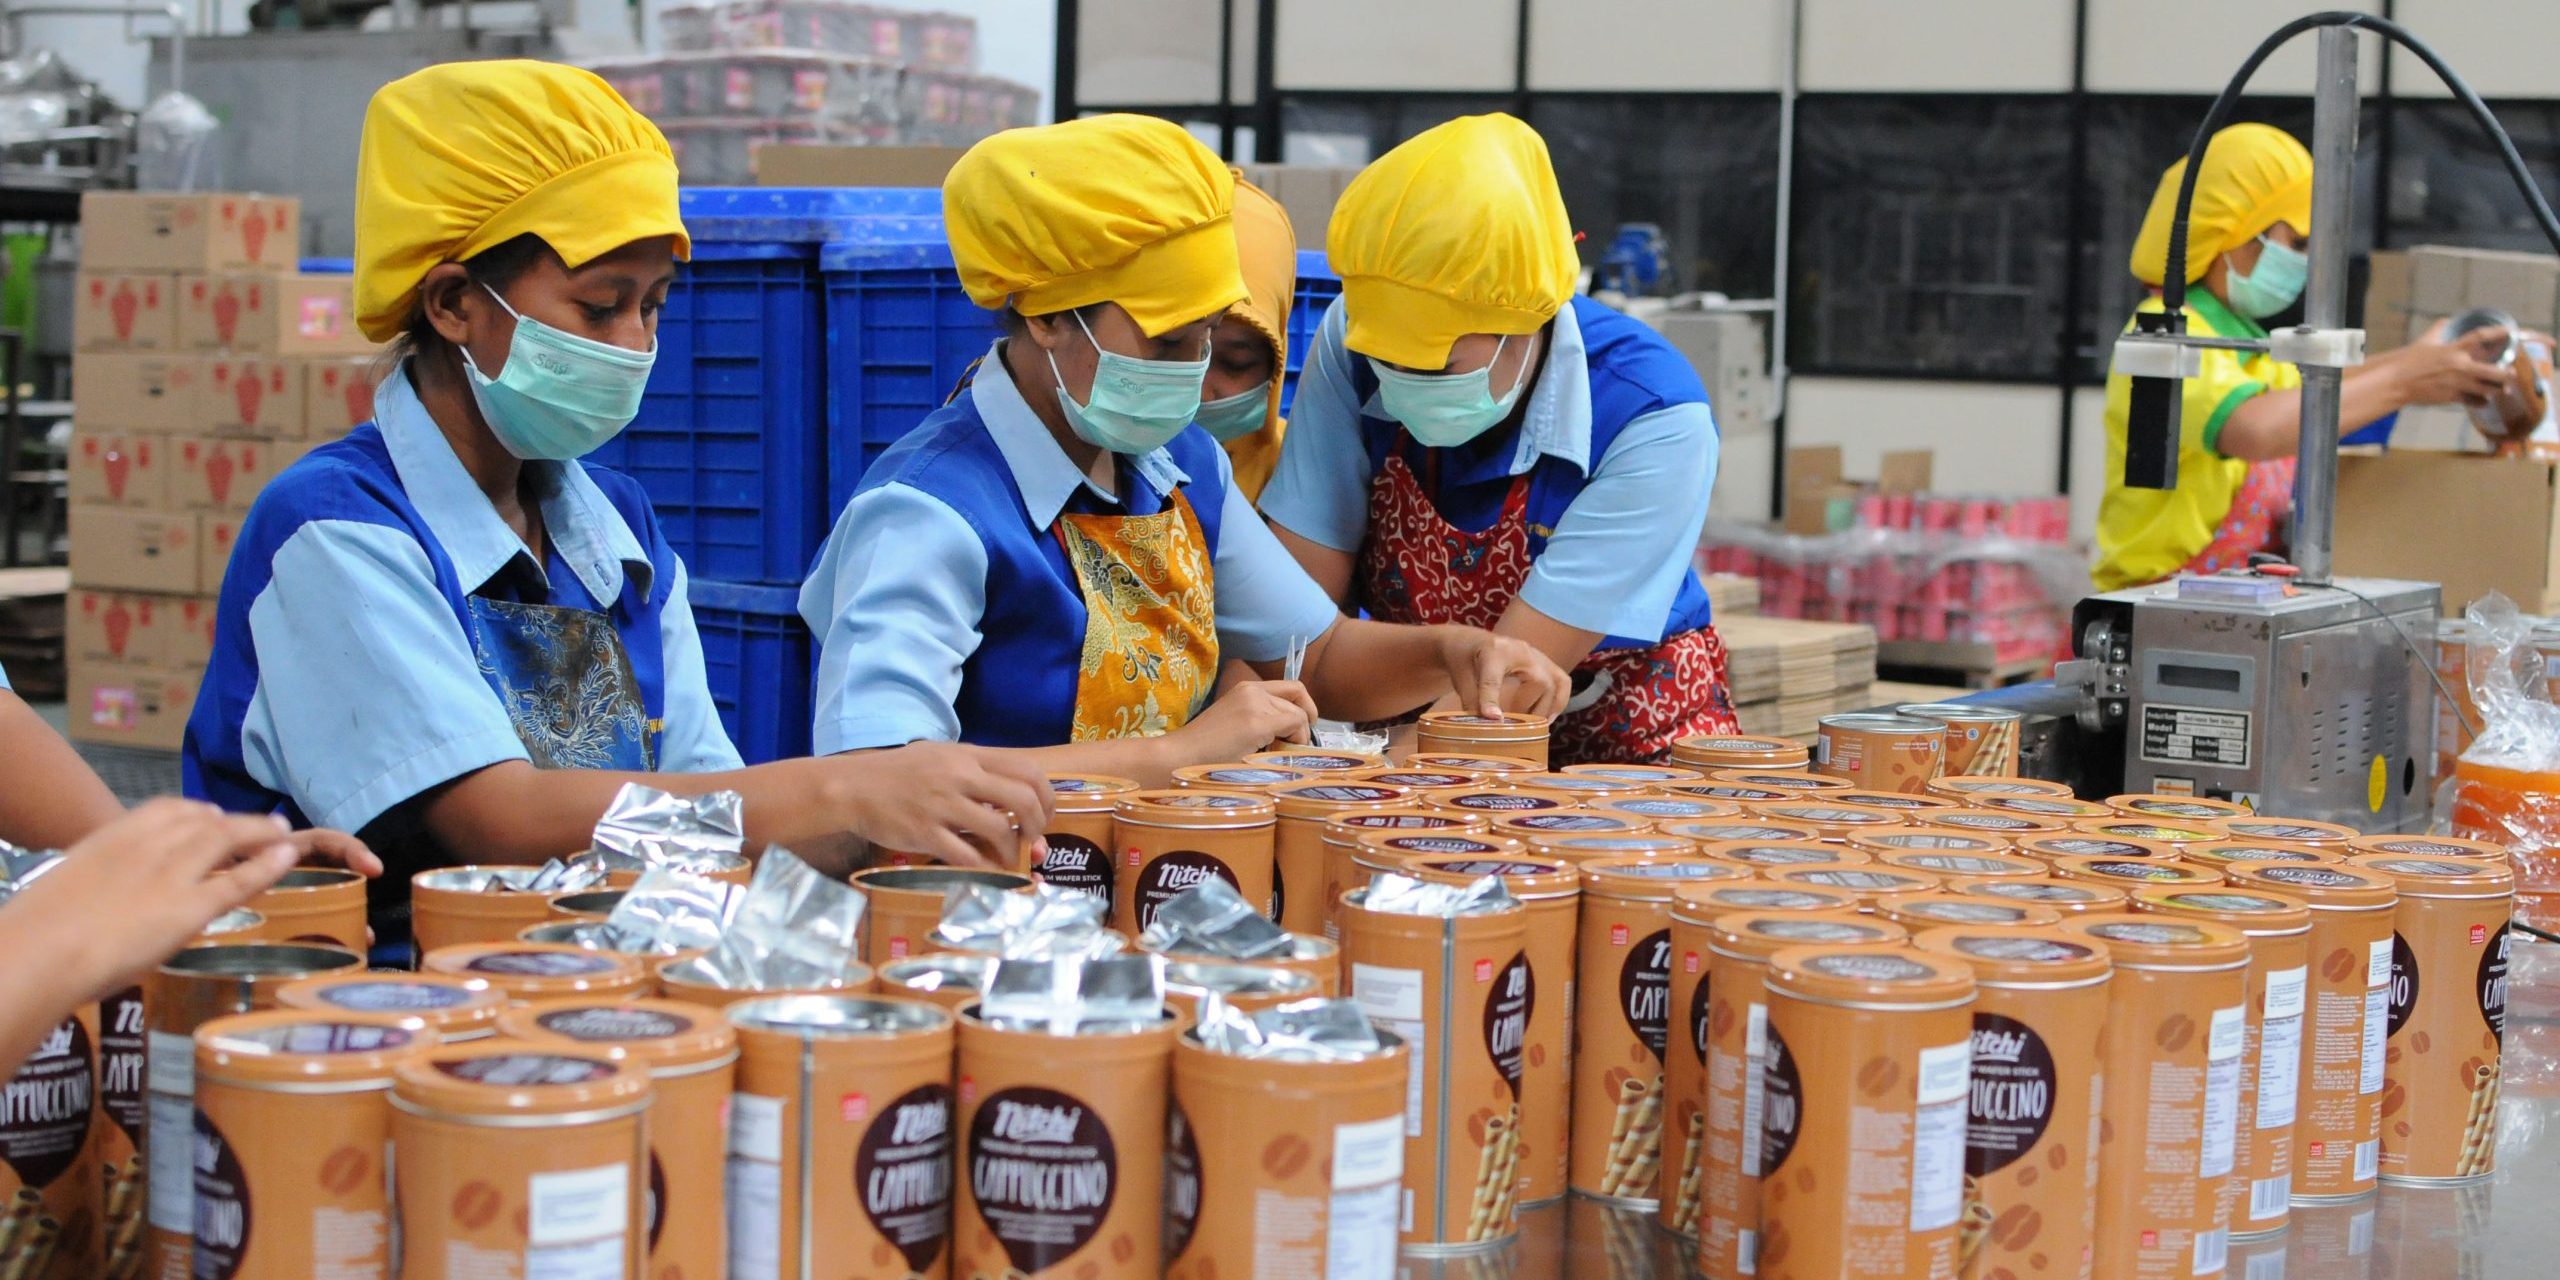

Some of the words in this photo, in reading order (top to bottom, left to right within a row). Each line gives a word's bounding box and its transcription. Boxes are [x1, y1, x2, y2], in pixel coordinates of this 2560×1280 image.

[1055, 874, 1081, 882] WAFER
[1082, 873, 1102, 882] STICK
[2266, 868, 2355, 883] CAPPUCCINO
[1969, 1078, 2048, 1121] UCCINO
